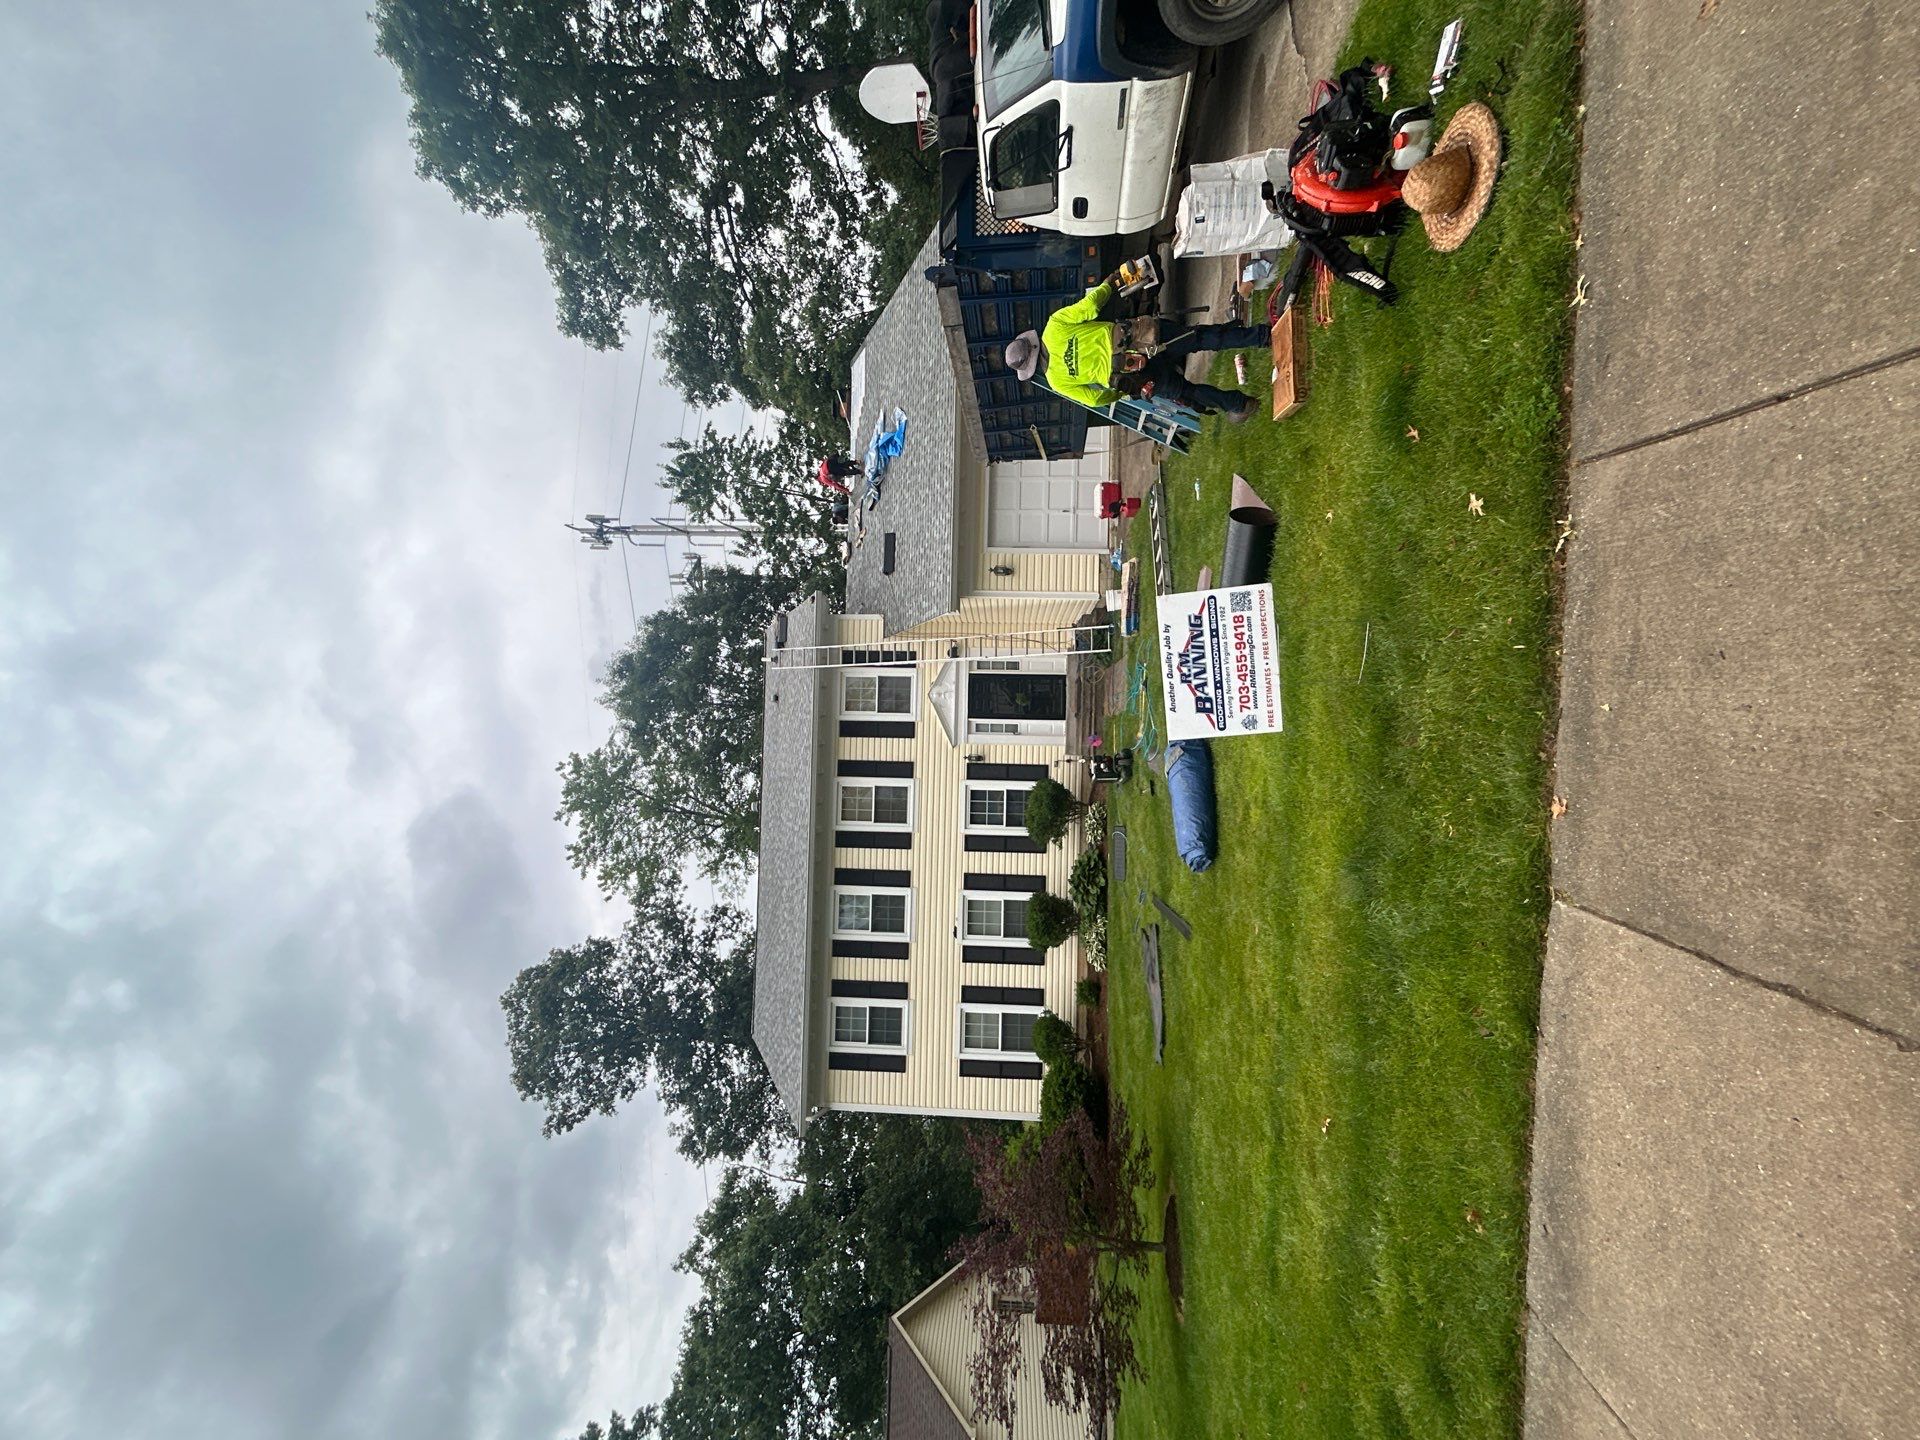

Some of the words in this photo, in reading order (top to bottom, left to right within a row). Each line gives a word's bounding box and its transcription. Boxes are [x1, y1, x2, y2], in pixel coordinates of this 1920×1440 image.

[1353, 271, 1386, 290] ECHO
[1163, 623, 1171, 633] by
[1209, 599, 1217, 629] SIDING
[1258, 589, 1268, 640] INSPECTIONS
[1163, 635, 1171, 650] Job
[1262, 641, 1270, 660] FREE
[1165, 651, 1174, 679] Quality
[1178, 649, 1192, 684] R.M.
[1188, 613, 1215, 715] BANNING
[1212, 637, 1221, 681] WINDOWS
[1246, 616, 1259, 710] www.RMBanningCo.com
[1168, 681, 1177, 713] Another
[1264, 667, 1274, 708] ESTIMATES
[1216, 689, 1225, 728] ROOFING
[1267, 709, 1275, 728] FREE
